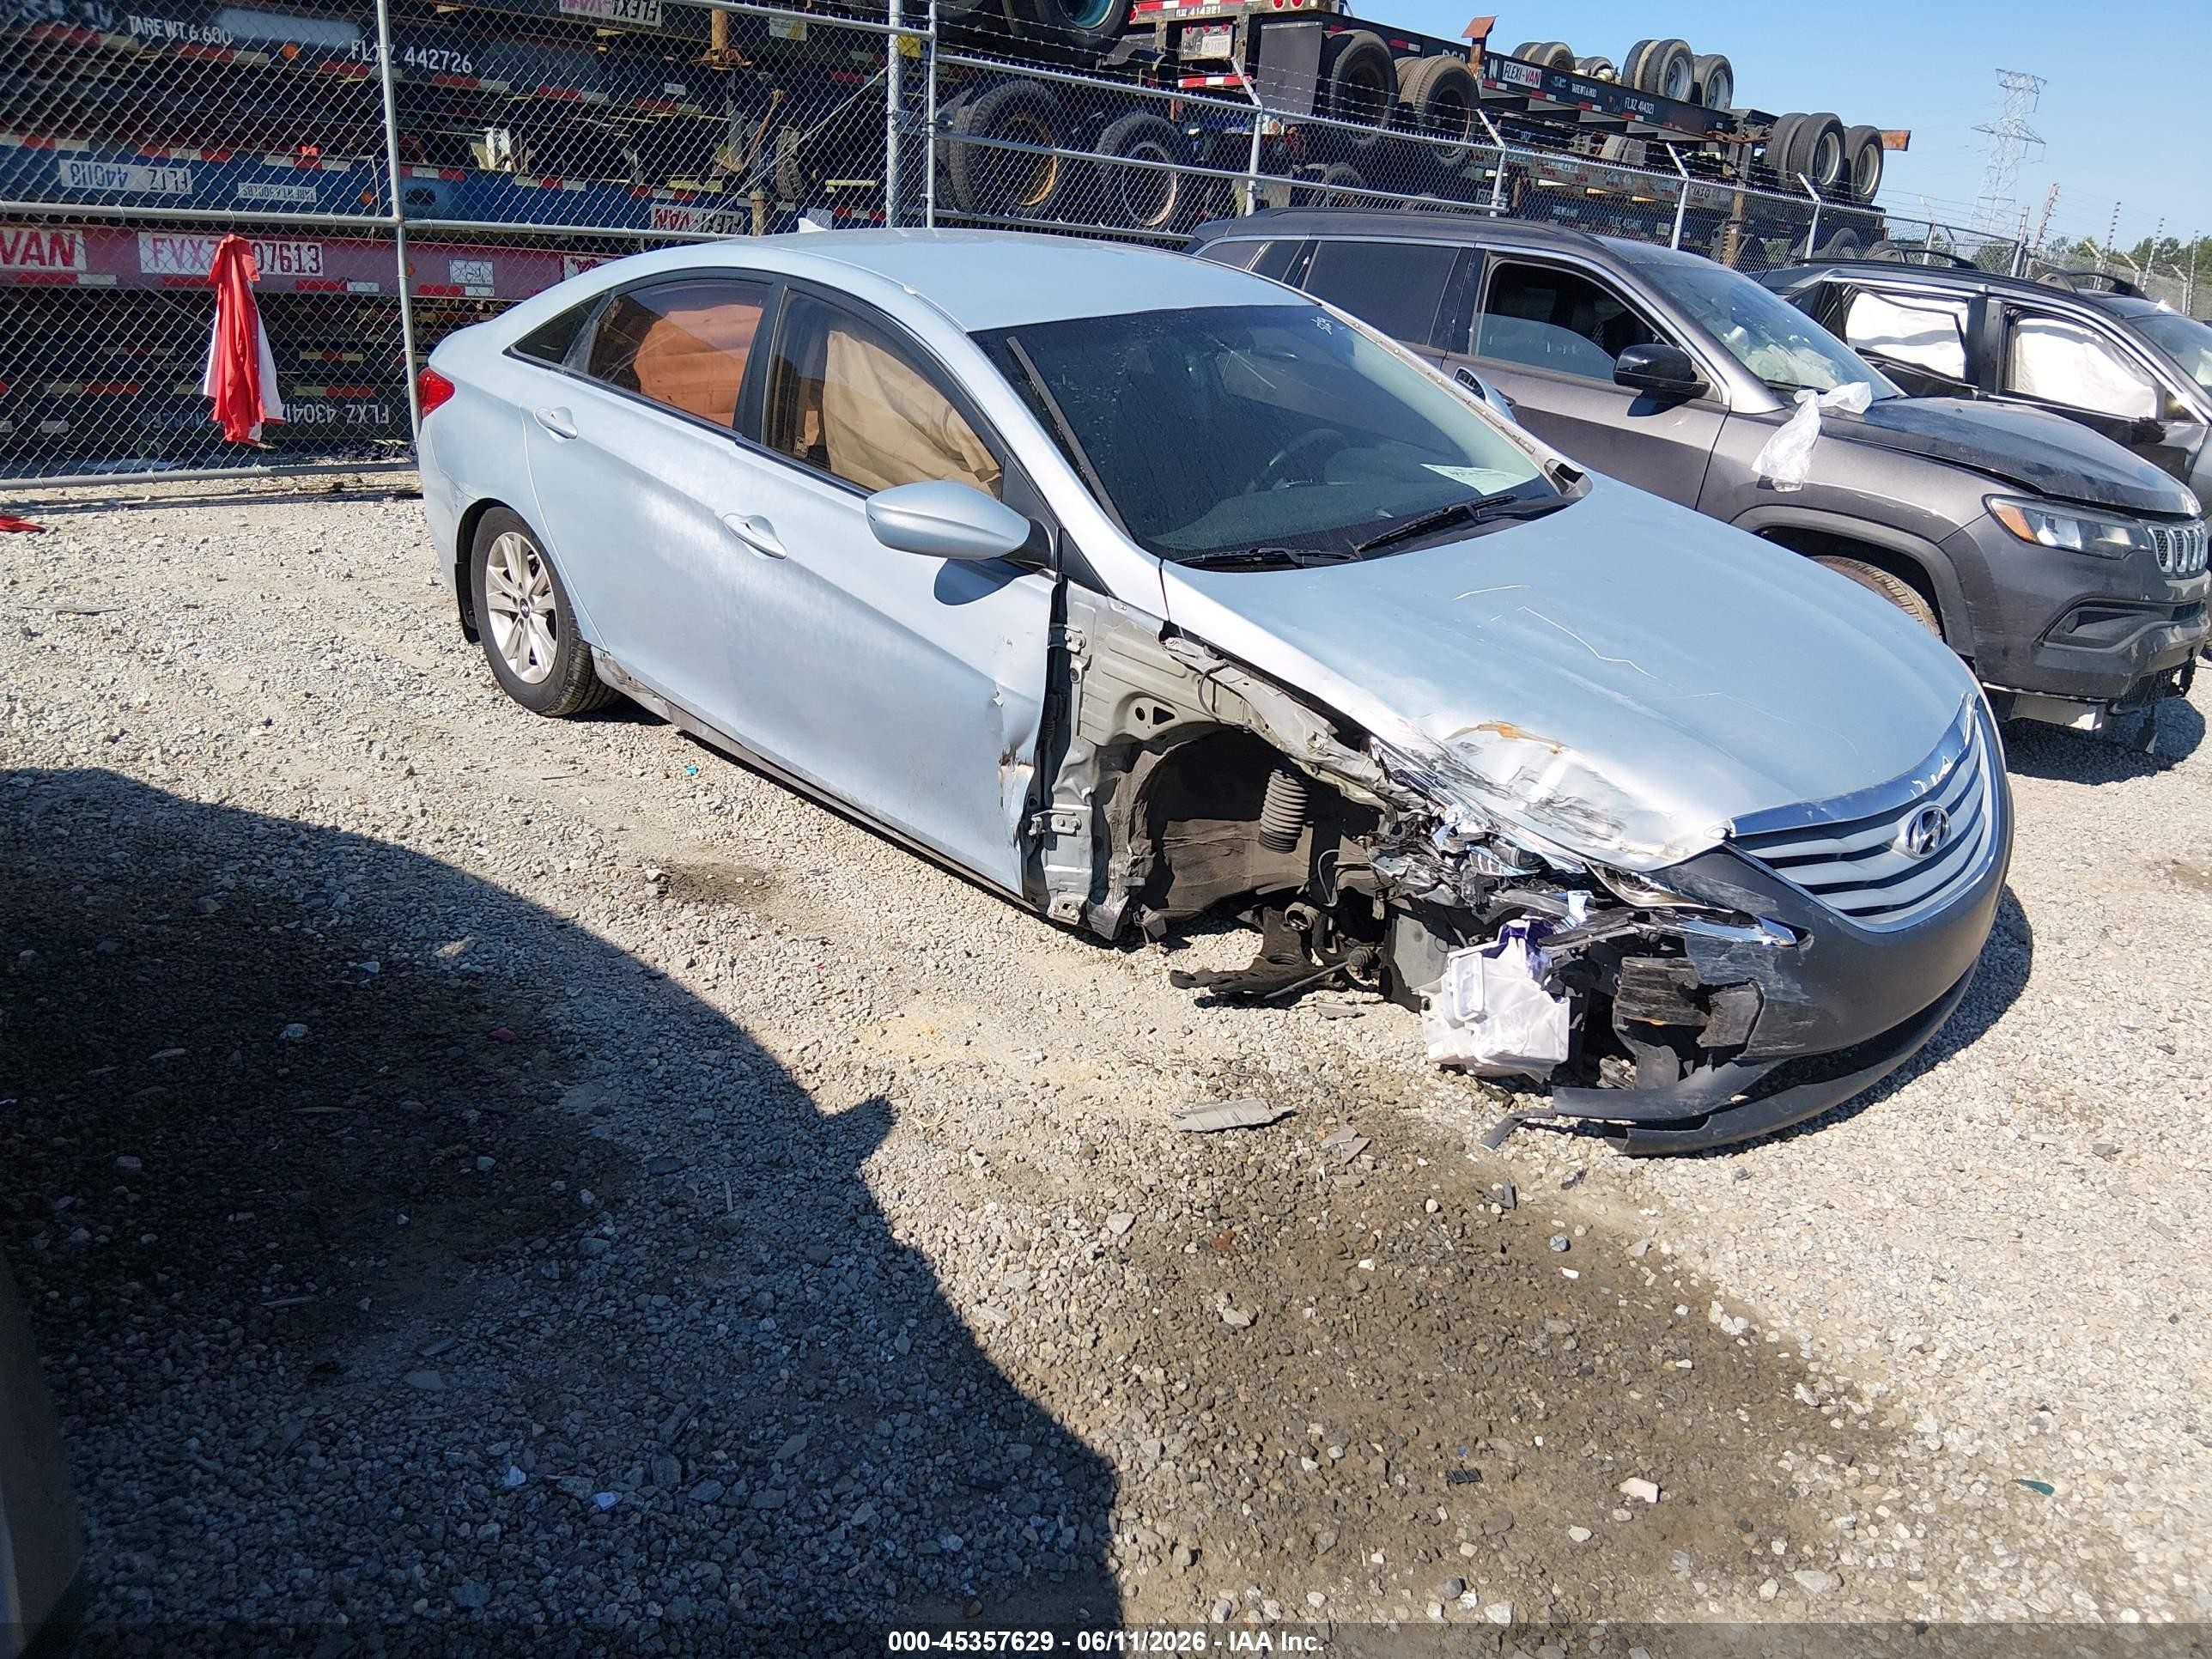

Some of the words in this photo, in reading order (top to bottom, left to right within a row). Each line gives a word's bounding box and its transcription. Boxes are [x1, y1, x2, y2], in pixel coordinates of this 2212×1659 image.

[404, 46, 472, 74] 442726
[1503, 64, 1541, 86] FLEXI-VAN
[345, 404, 390, 424] FLXZ
